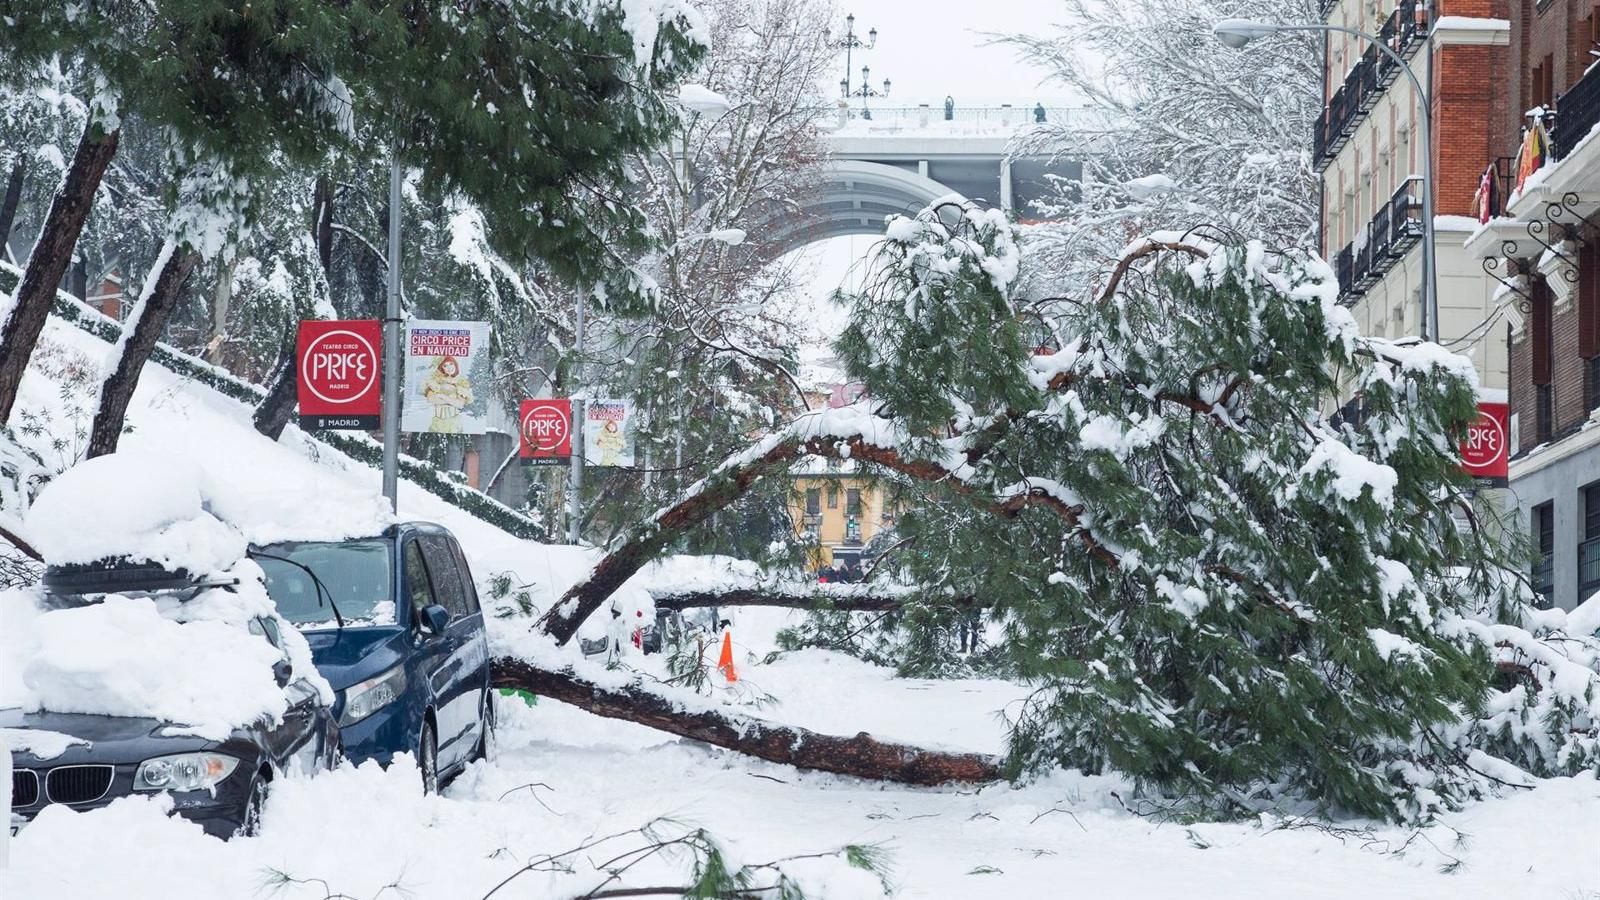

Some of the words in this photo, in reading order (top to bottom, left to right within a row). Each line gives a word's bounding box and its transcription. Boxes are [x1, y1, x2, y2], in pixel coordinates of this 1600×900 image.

[412, 335, 439, 345] CIRCO
[442, 336, 469, 346] PRICE
[412, 346, 424, 355] EN
[427, 346, 467, 356] NAVIDAD
[313, 353, 367, 380] PRICE
[328, 419, 360, 427] MADRID
[529, 419, 562, 437] PRICE
[1467, 428, 1496, 450] RICE
